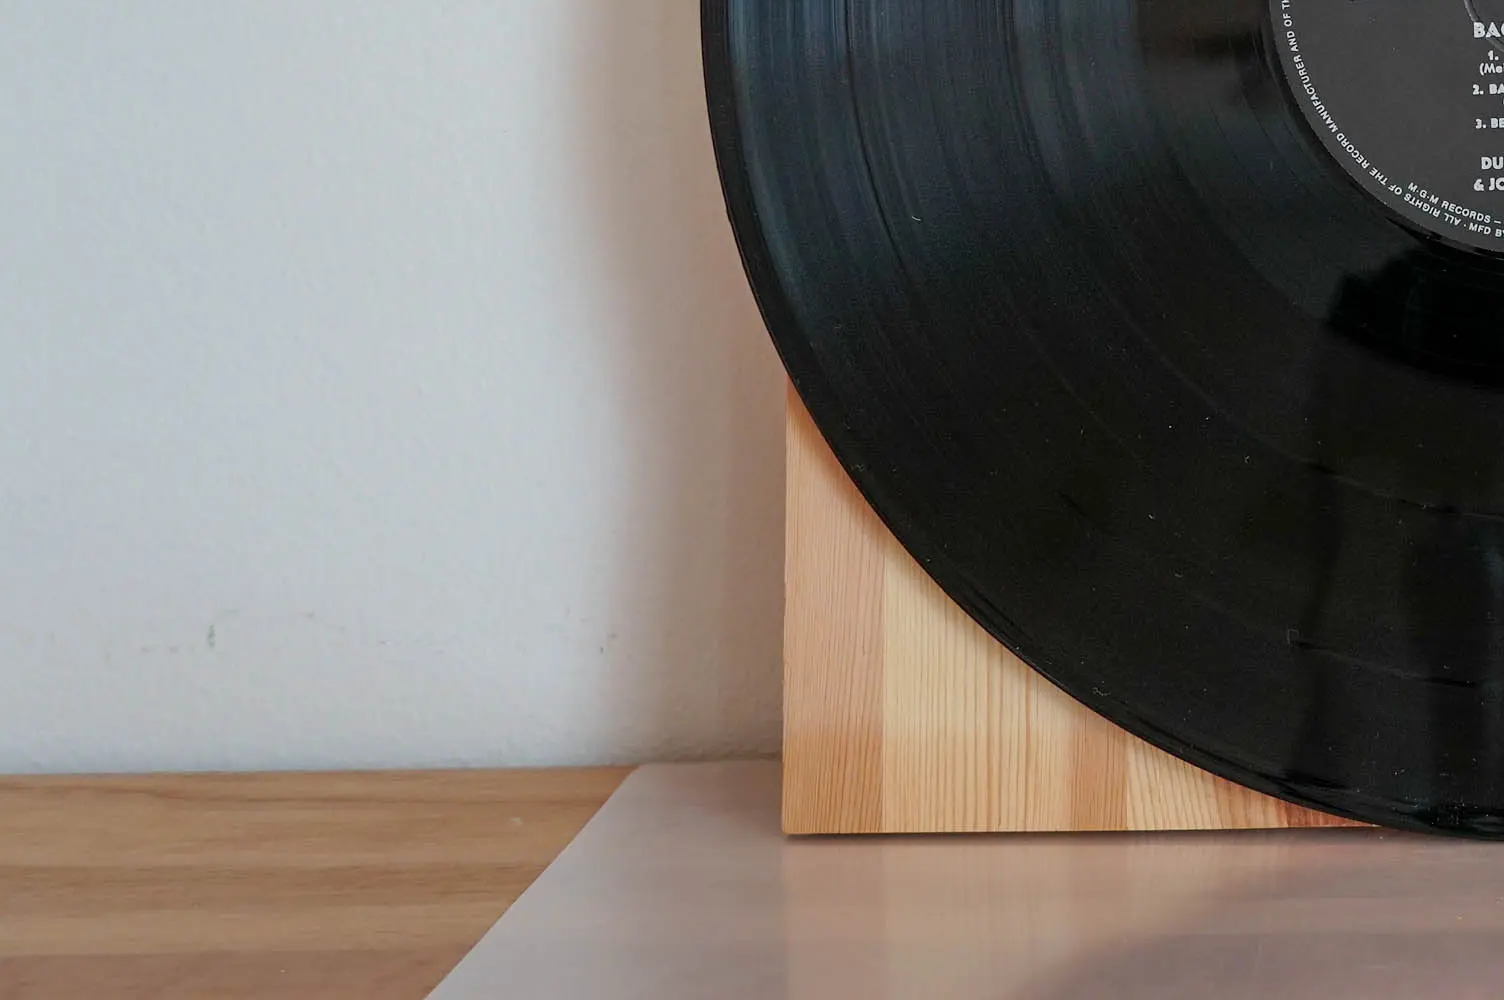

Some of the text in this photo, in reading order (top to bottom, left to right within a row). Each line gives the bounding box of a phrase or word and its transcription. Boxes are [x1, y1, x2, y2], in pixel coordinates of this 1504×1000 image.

[1282, 13, 1293, 28] OF
[1286, 30, 1299, 52] AND
[1487, 49, 1500, 61] 1.
[1293, 54, 1339, 133] MANUFACTURER
[1472, 83, 1484, 96] 2.
[1475, 118, 1487, 130] 3.
[1336, 132, 1371, 169] RECORD
[1368, 167, 1388, 186] THE
[1387, 184, 1403, 196] OF
[1473, 178, 1485, 192] &
[1403, 192, 1441, 218] RIGHTS
[1440, 200, 1491, 224] RECORDS
[1443, 212, 1462, 226] ALL
[1468, 222, 1492, 235] MFD
